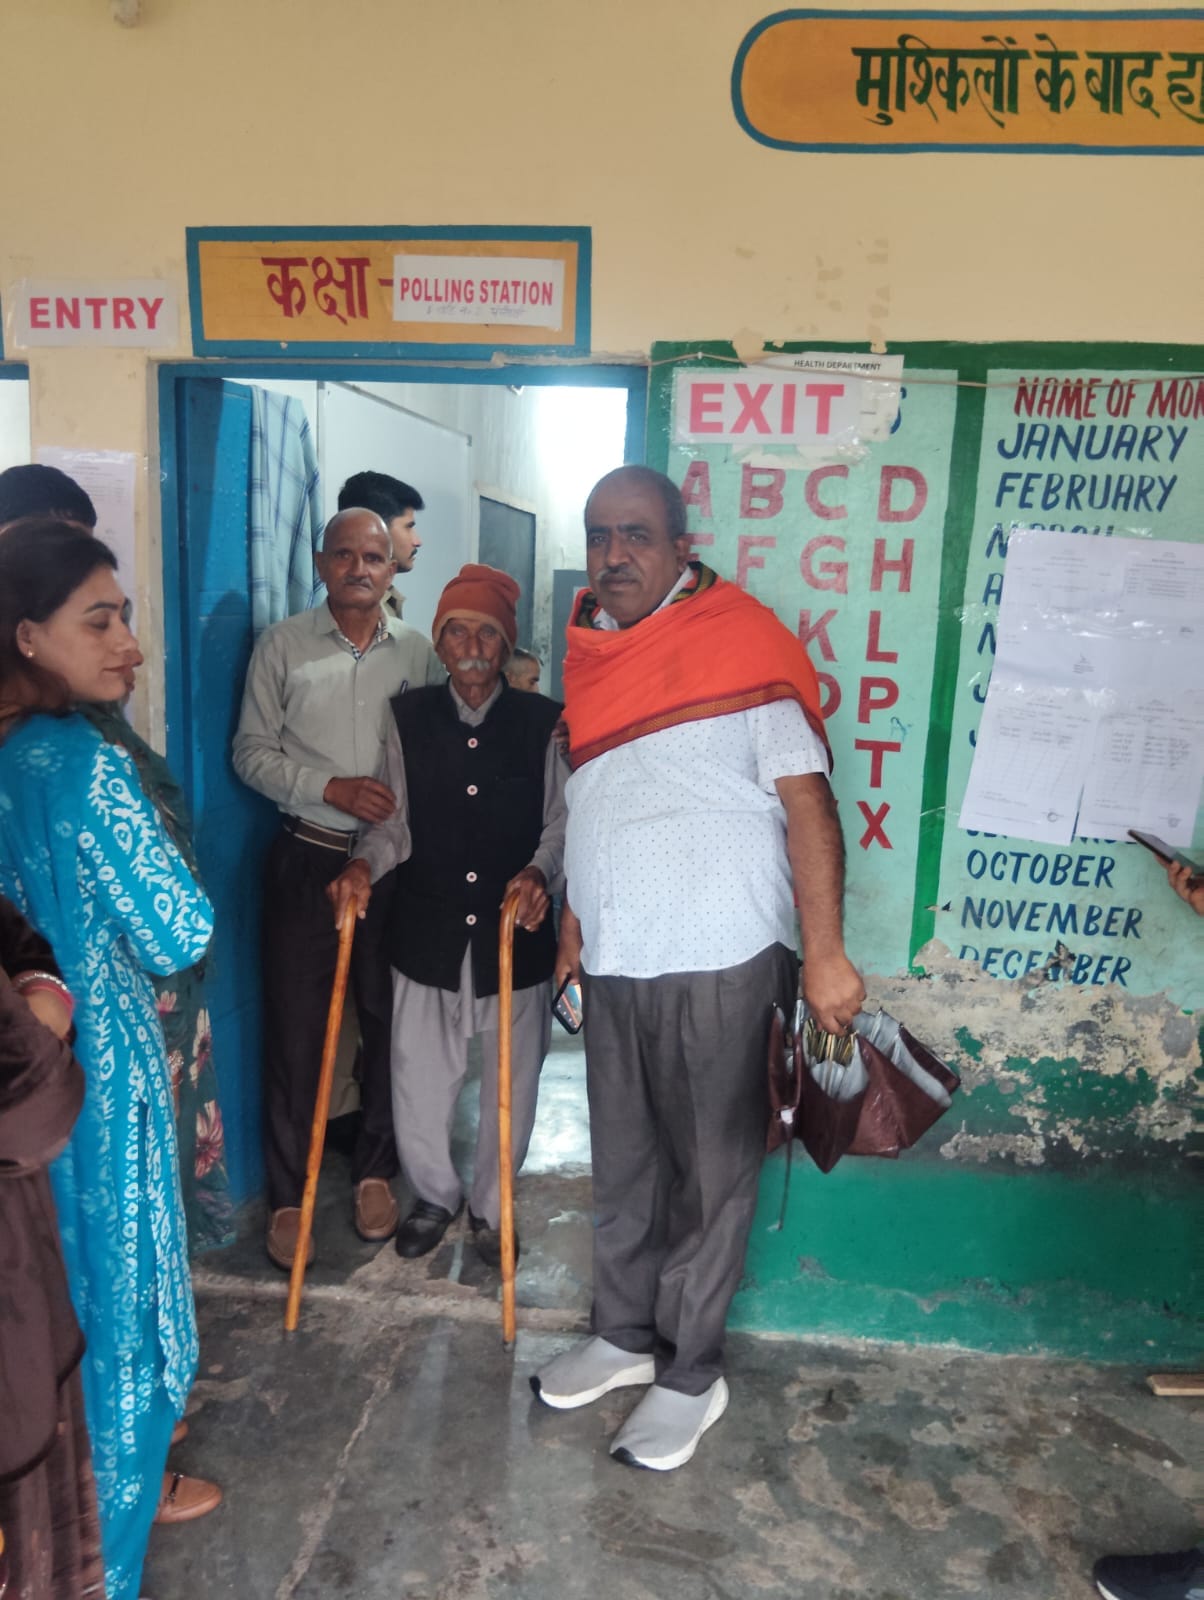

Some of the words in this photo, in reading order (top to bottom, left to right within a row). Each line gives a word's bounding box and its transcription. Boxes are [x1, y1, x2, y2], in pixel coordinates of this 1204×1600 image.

[852, 34, 1030, 128] मुश्किलों
[1034, 33, 1078, 113] के
[1085, 51, 1163, 118] बाद
[29, 297, 164, 329] ENTRY
[400, 277, 474, 303] POLLING
[480, 279, 553, 305] STATION
[794, 359, 824, 368] HEALTH
[689, 383, 845, 434] EXIT
[1013, 376, 1102, 421] NAME
[1106, 378, 1139, 418] OF
[997, 422, 1188, 463] JANUARY
[680, 461, 712, 518] A
[739, 462, 786, 519] B
[804, 464, 848, 520] C
[876, 465, 928, 522] D
[995, 472, 1178, 513] FEBRUARY
[735, 535, 776, 590] F
[800, 535, 848, 594] G
[869, 538, 915, 593] H
[797, 609, 838, 662] K
[866, 610, 898, 664] L
[857, 676, 899, 724] P
[854, 739, 901, 789] T
[856, 801, 893, 850] X
[966, 849, 1116, 888] OCTOBER
[960, 896, 1143, 939] NOVEMBER
